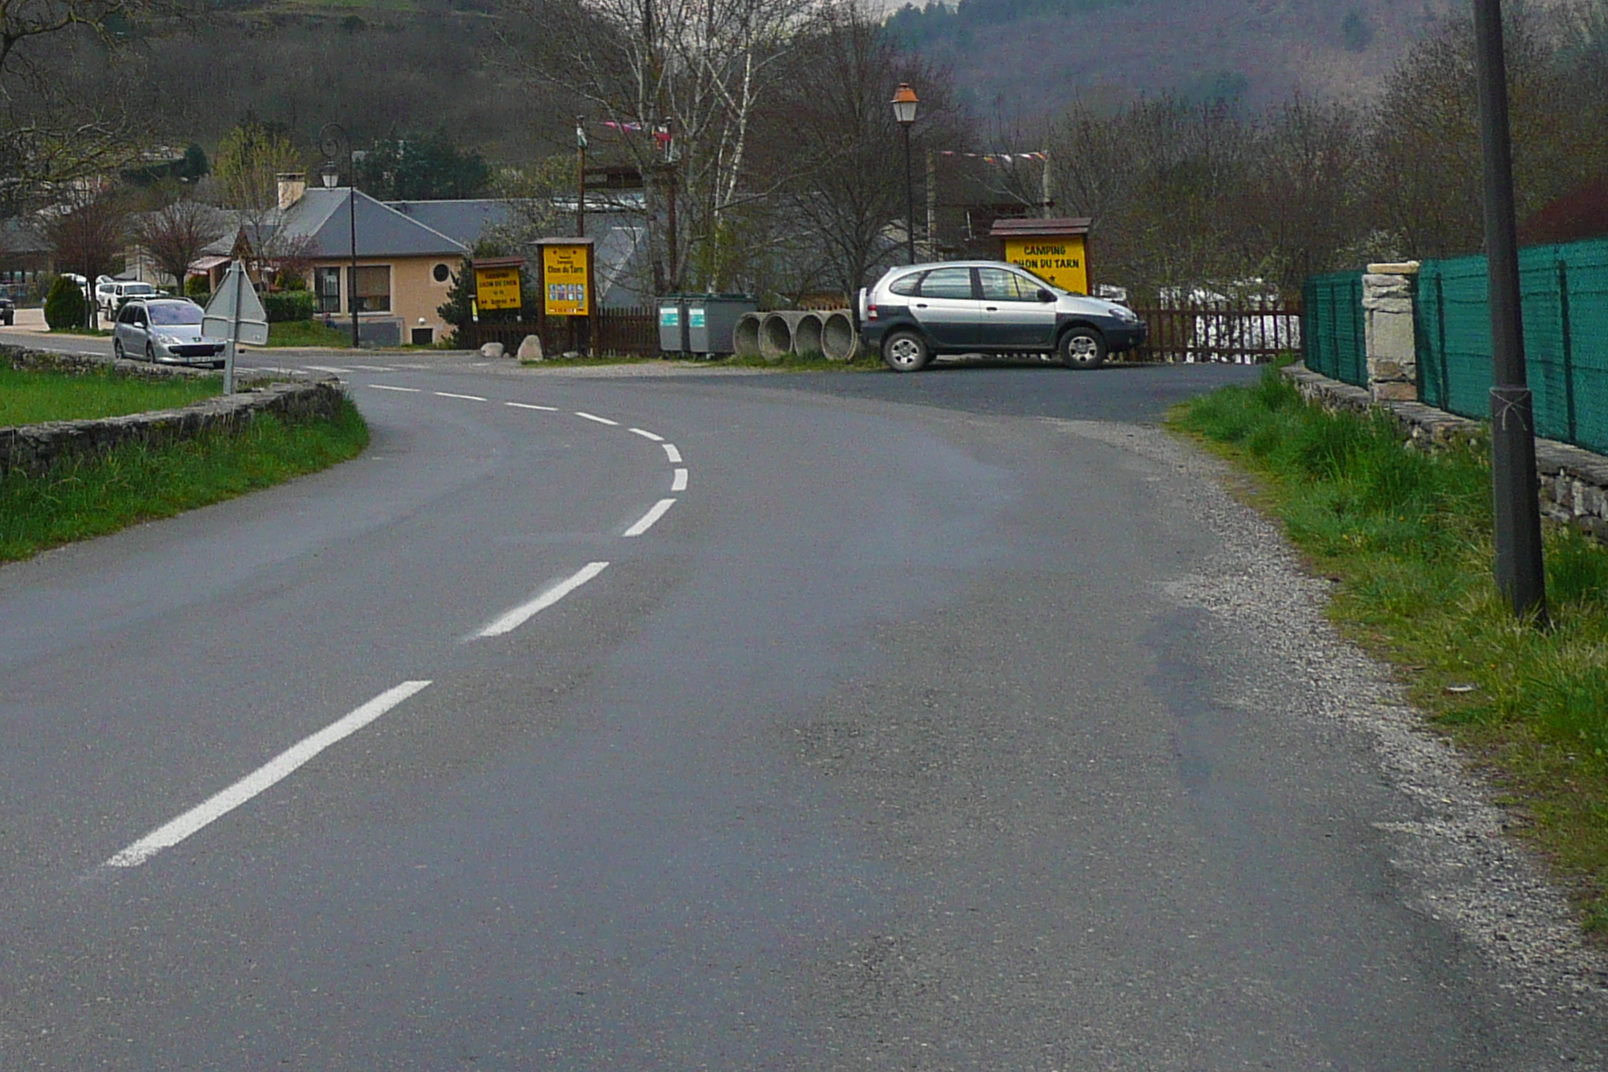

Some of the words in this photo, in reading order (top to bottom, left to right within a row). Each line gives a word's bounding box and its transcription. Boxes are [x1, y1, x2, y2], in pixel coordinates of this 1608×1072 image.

[1024, 245, 1066, 255] CAMPING
[1040, 259, 1052, 268] DU
[1054, 259, 1079, 268] TARN
